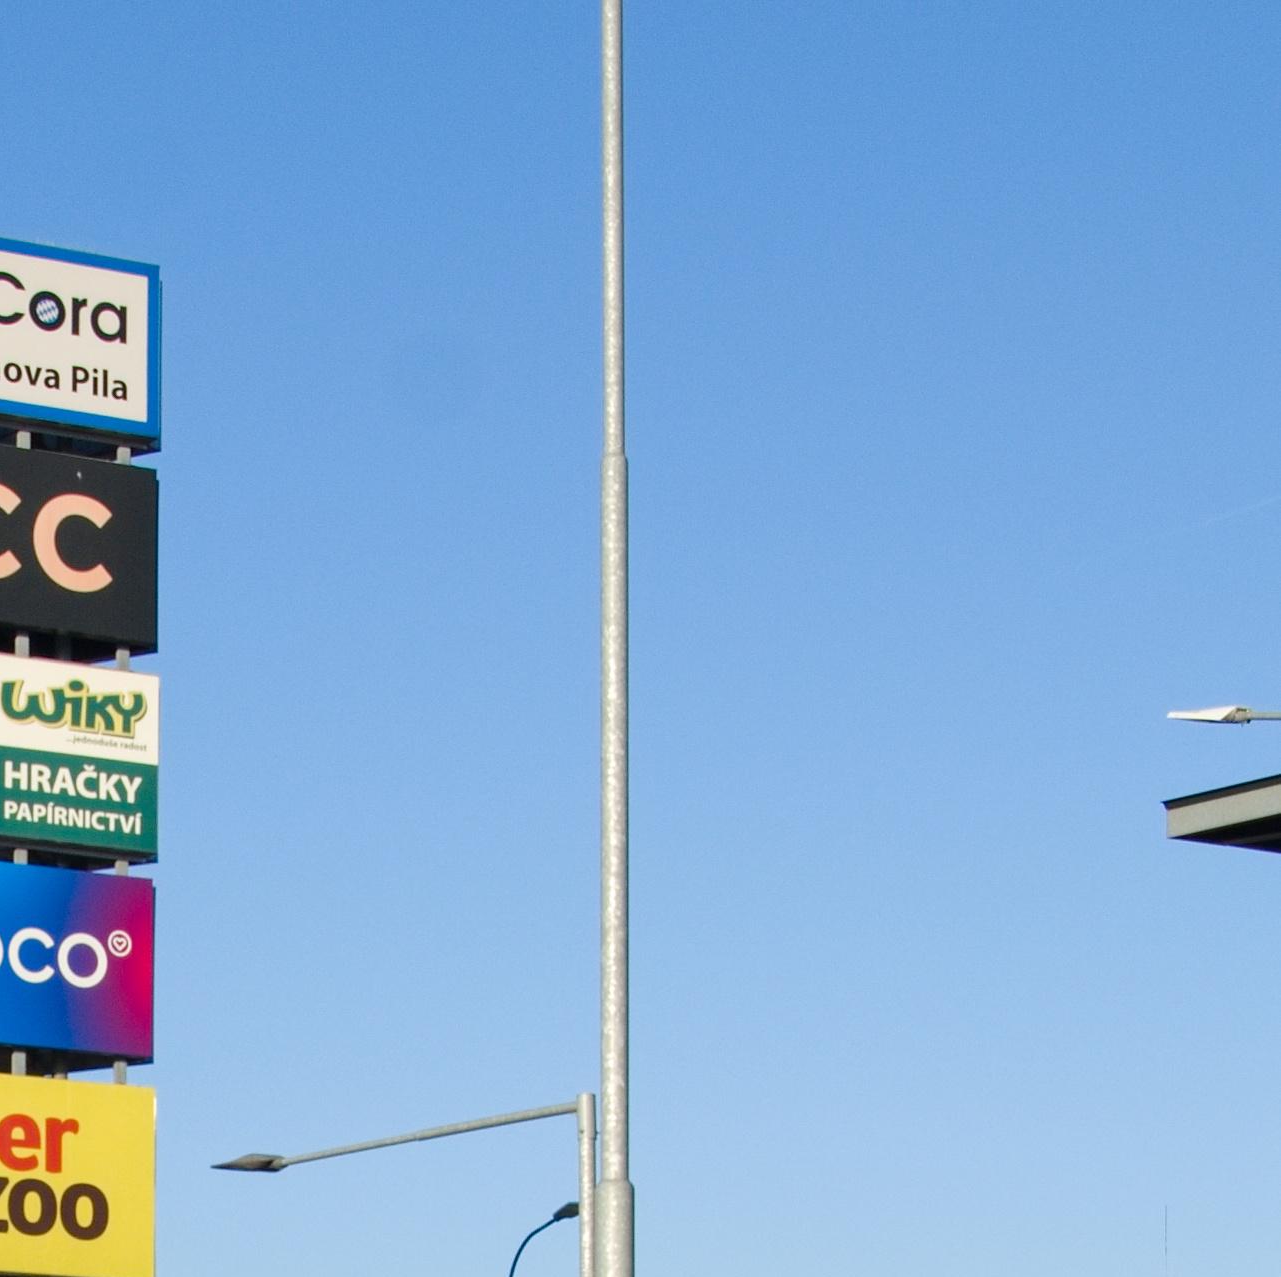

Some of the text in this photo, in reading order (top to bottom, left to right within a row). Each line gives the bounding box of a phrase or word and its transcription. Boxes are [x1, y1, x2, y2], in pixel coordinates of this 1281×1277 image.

[71, 366, 128, 400] Pila
[4, 760, 142, 803] HRAČKY
[3, 800, 141, 835] PAPÍRNICTVÍ
